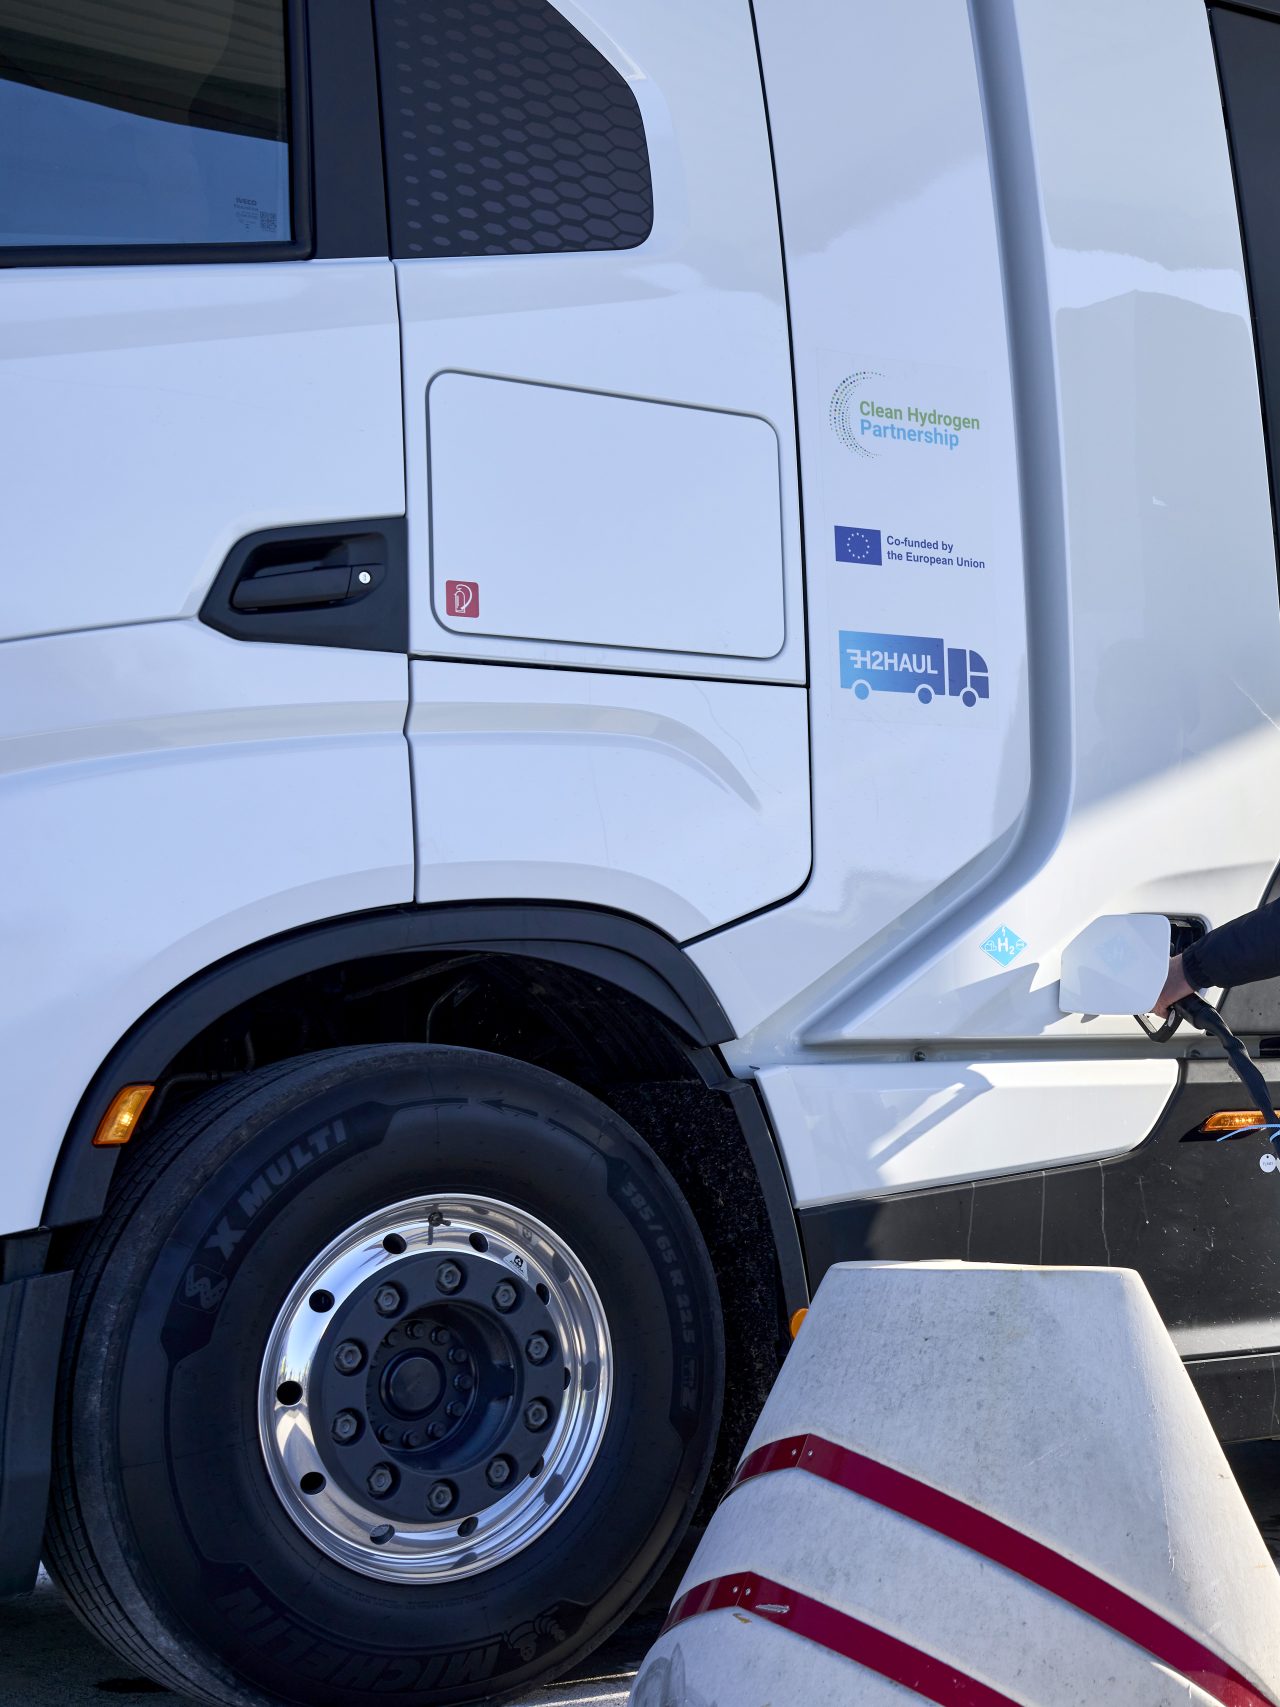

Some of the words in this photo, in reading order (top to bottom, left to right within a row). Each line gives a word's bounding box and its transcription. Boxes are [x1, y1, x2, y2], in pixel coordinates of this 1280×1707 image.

[860, 400, 903, 420] Clean
[907, 406, 980, 431] Hydrogen
[860, 419, 959, 450] Partnership
[887, 535, 939, 550] Co-funded
[941, 541, 954, 553] by
[887, 550, 903, 561] the
[906, 551, 954, 566] European
[956, 556, 985, 569] Union
[847, 649, 938, 675] H2HAUL
[238, 1119, 347, 1219] MULTI
[211, 1586, 503, 1692] MICHELIN
